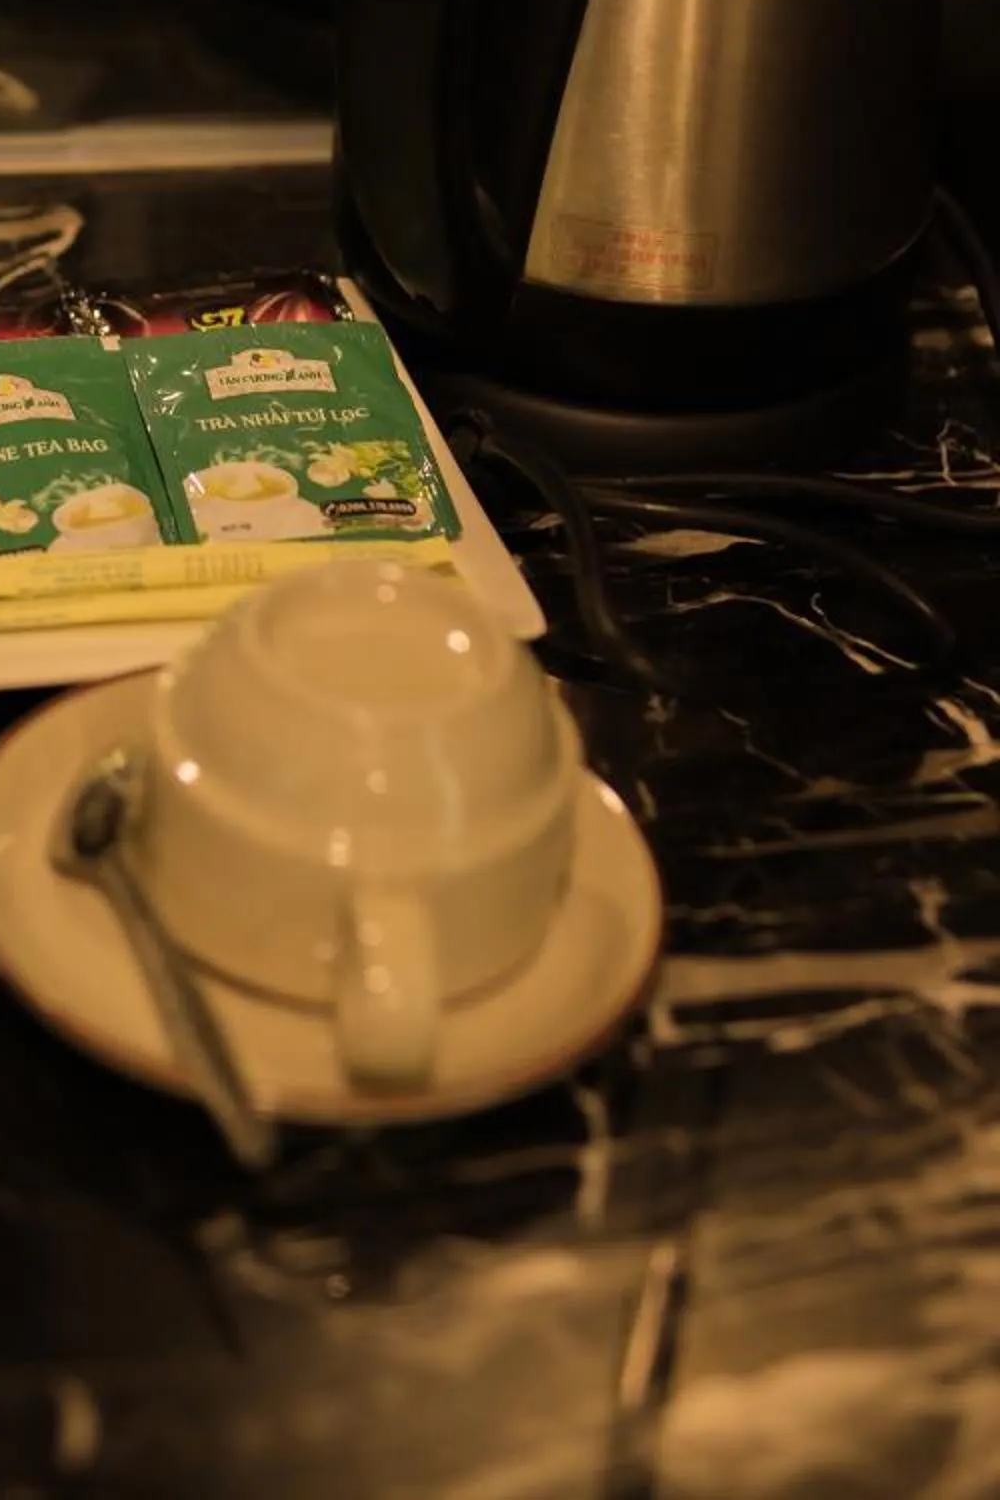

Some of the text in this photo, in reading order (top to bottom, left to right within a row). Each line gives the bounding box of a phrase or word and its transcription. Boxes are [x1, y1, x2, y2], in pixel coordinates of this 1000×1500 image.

[330, 406, 371, 429] LỌC
[24, 441, 63, 457] TEA
[66, 437, 108, 452] BAG
